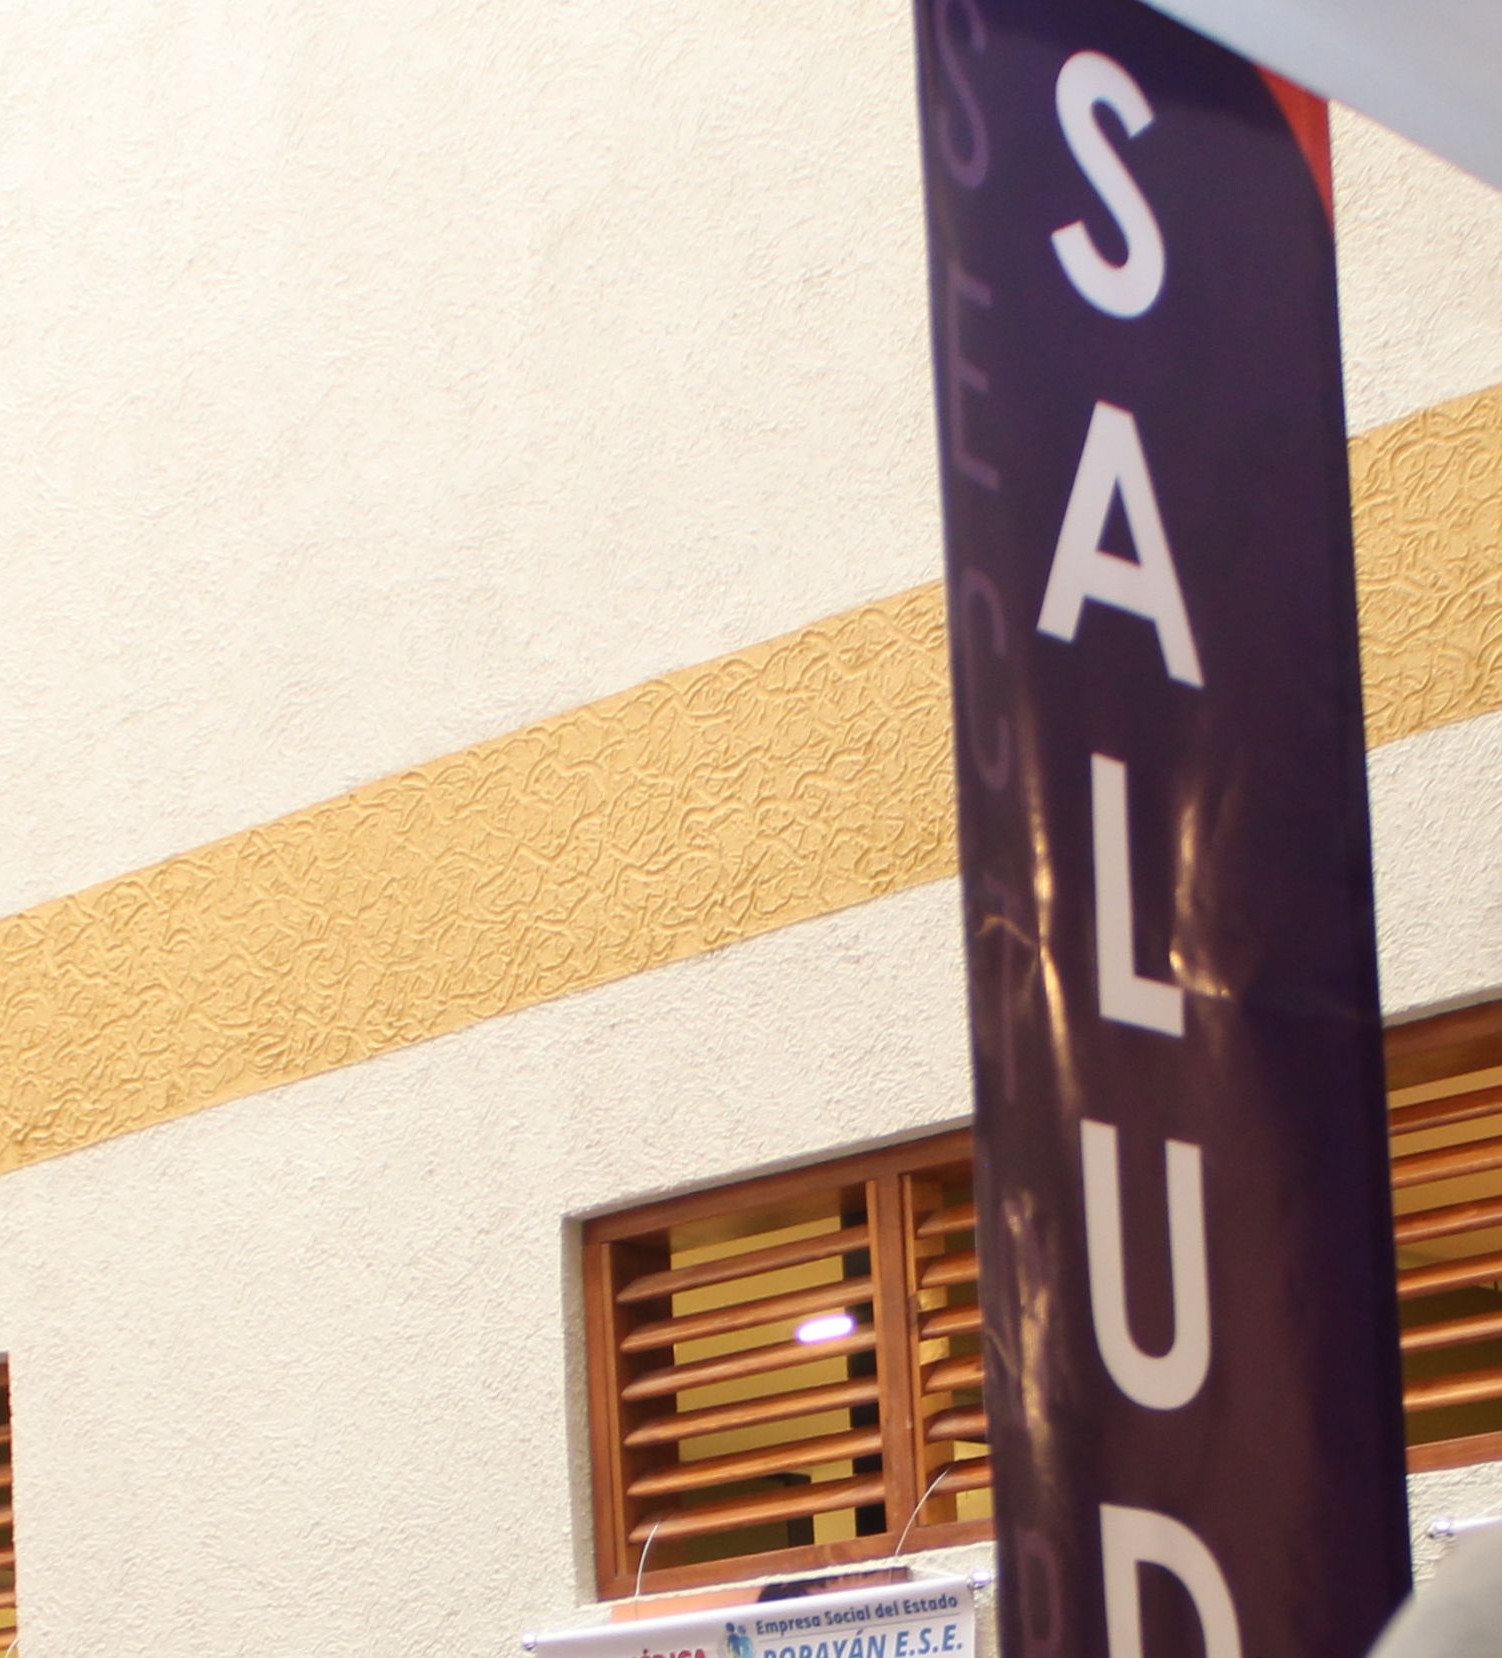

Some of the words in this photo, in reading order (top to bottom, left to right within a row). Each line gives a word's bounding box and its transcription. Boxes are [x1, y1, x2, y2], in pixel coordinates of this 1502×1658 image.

[755, 1614, 821, 1637] Empresa
[825, 1605, 871, 1626] Social
[875, 1600, 899, 1619] del
[904, 1594, 958, 1615] Estado
[894, 1624, 963, 1658] E.S.E.
